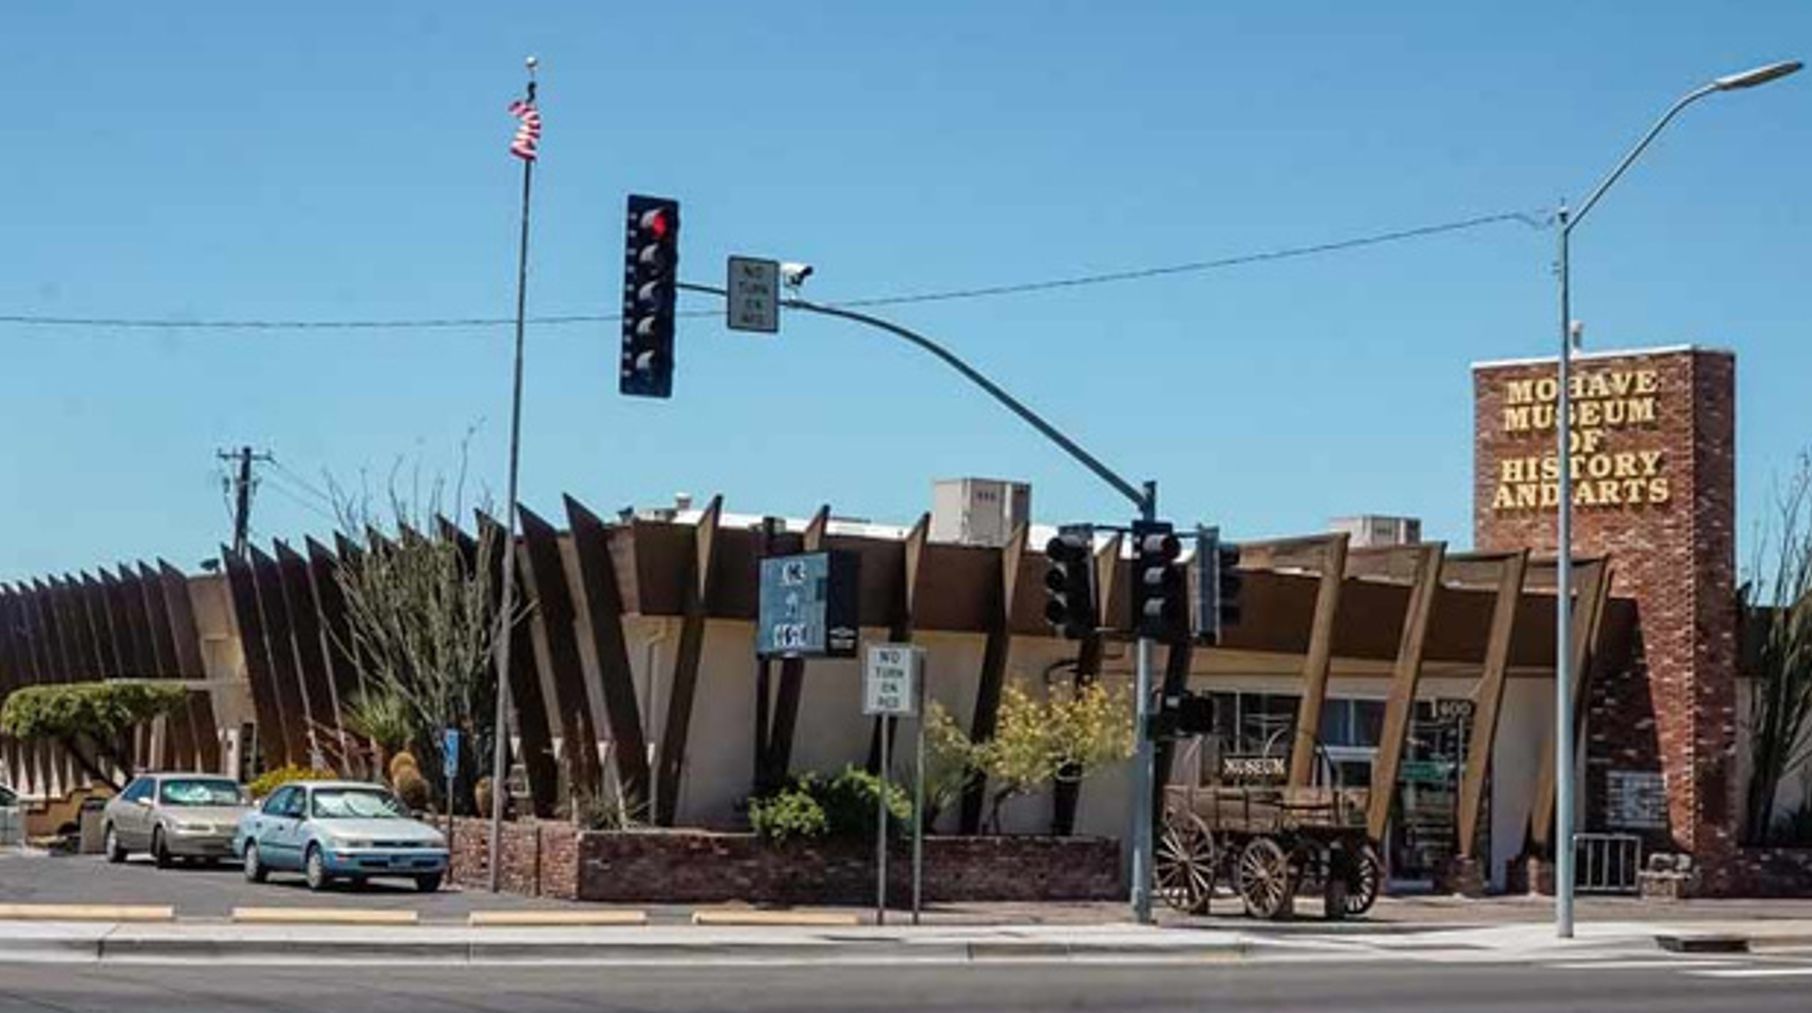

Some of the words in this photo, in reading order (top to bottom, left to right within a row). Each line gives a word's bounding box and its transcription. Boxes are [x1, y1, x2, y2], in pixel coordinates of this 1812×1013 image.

[1507, 370, 1658, 404] MOHAVE
[1501, 451, 1661, 483] HISTORY
[1491, 483, 1560, 509] AND
[1573, 477, 1670, 506] ARTS
[879, 650, 901, 664] NO
